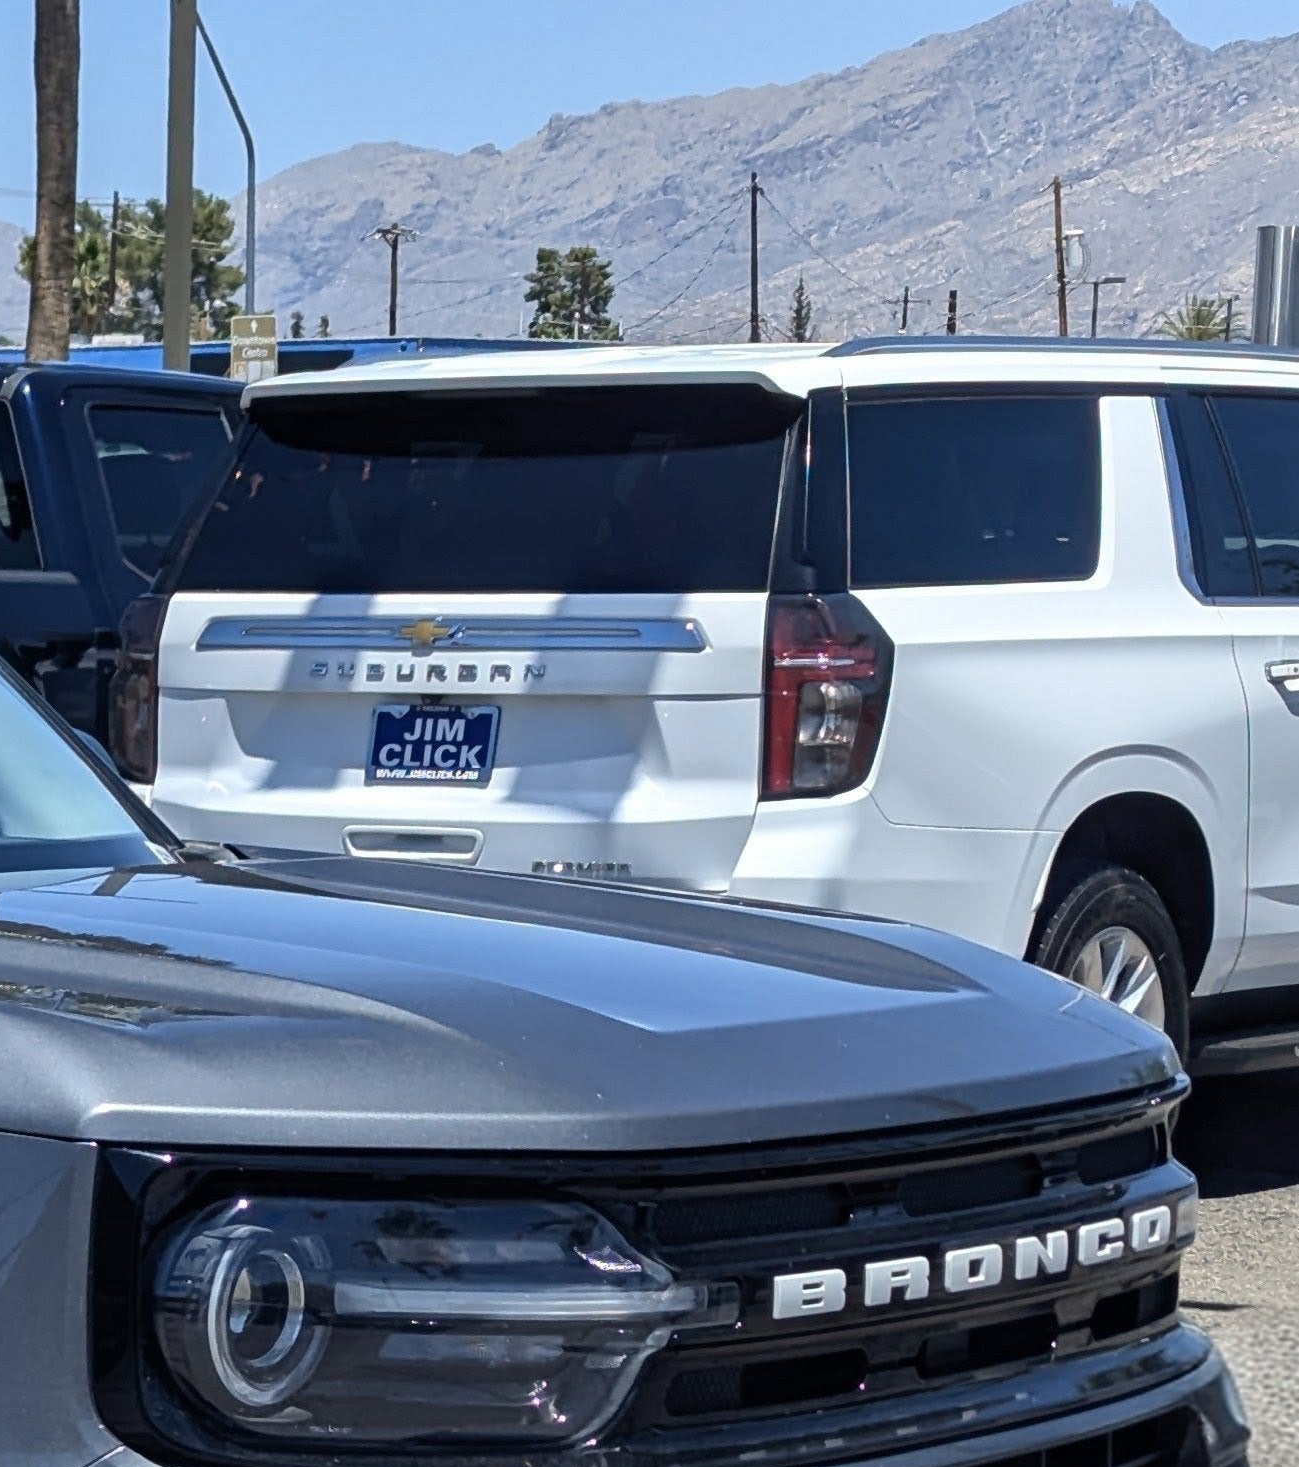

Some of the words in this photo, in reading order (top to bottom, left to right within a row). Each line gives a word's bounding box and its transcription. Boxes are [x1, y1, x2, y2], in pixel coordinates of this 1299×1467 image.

[309, 662, 547, 684] SUBURBAN
[403, 718, 466, 742] JIM
[378, 743, 483, 768] CLICK
[772, 1205, 1172, 1320] BRONCO
